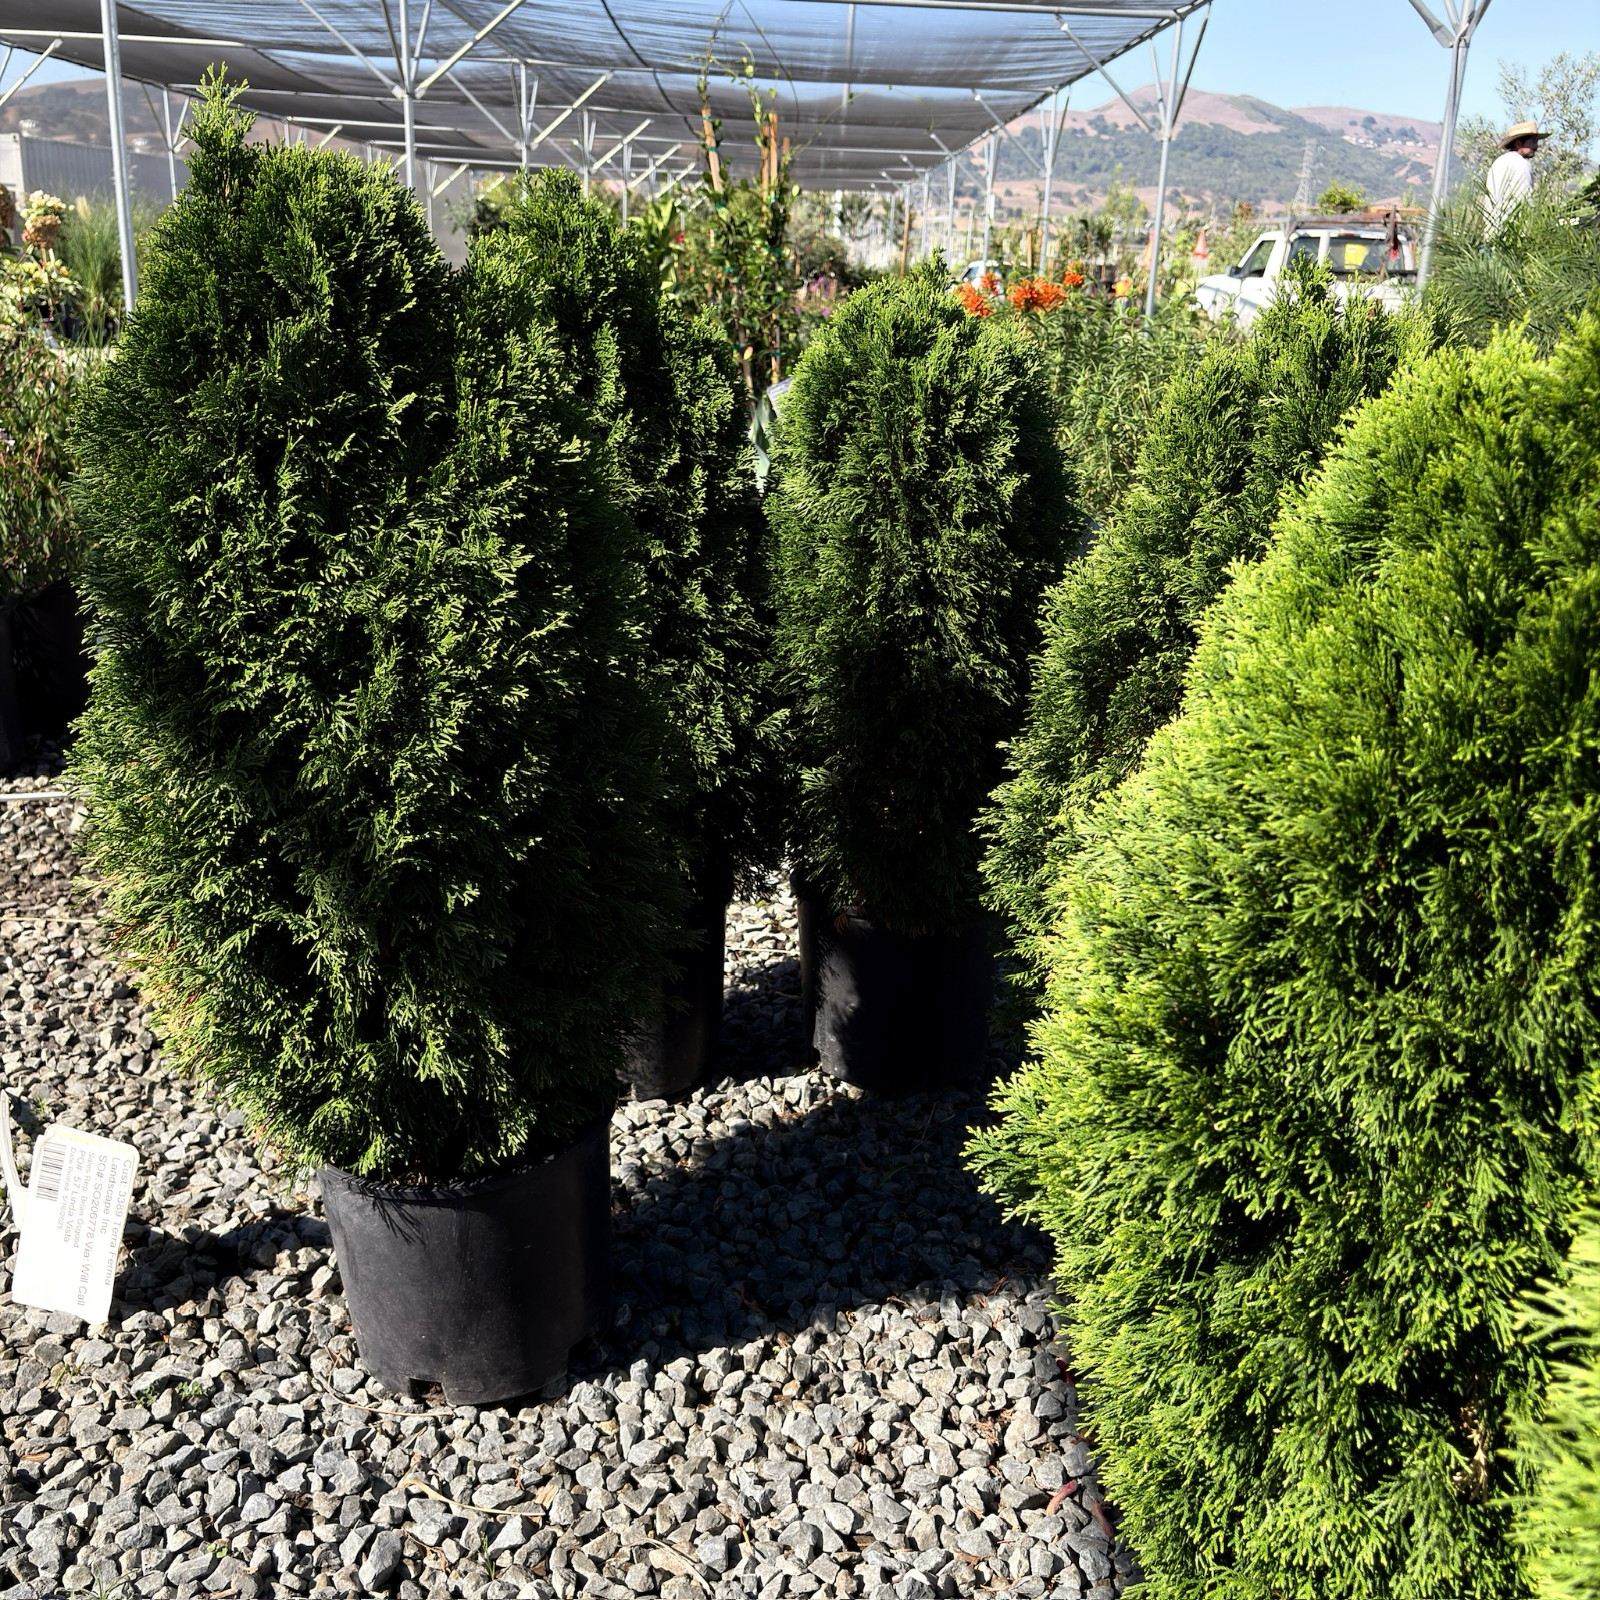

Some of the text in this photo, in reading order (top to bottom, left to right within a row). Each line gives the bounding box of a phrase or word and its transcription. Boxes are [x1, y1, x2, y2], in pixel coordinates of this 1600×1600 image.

[73, 1176, 82, 1189] 57
[68, 1191, 79, 1217] Linda
[79, 1196, 88, 1216] Brian
[100, 1157, 121, 1235] Landscape Inc
[115, 1191, 127, 1218] 3389
[86, 1183, 103, 1239] SO206778
[63, 1220, 75, 1243] Vista
[73, 1218, 84, 1249] Osgood
[110, 1222, 122, 1249] Terra
[80, 1264, 91, 1284] Will
[105, 1251, 117, 1286] Ferma
[77, 1286, 88, 1307] Call
